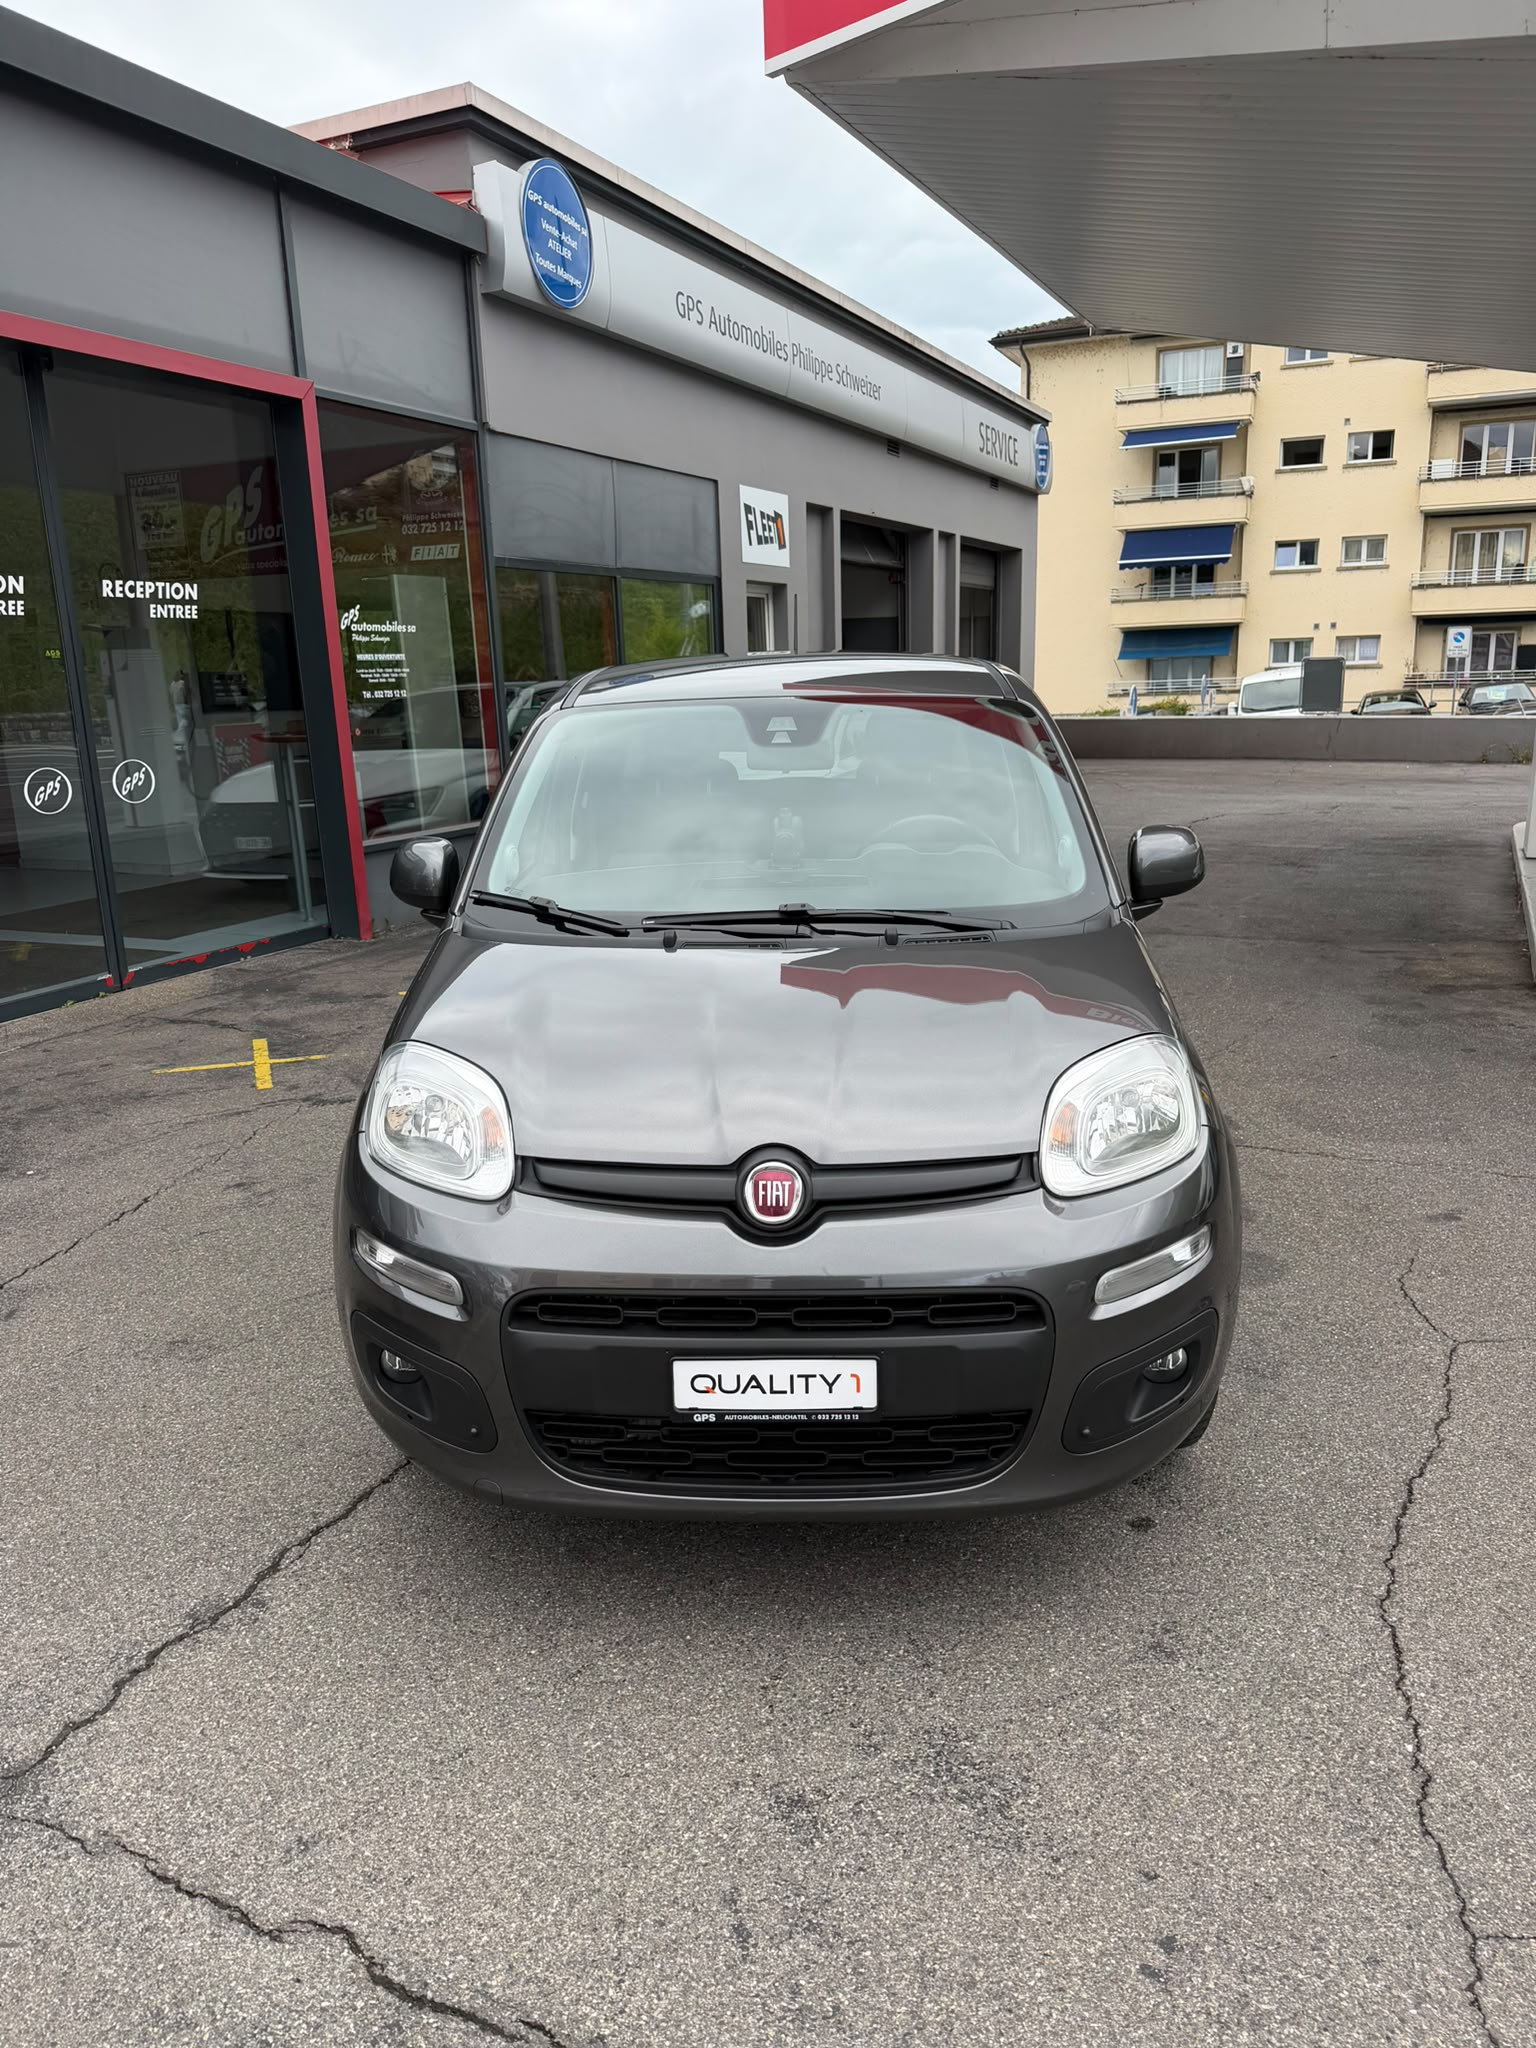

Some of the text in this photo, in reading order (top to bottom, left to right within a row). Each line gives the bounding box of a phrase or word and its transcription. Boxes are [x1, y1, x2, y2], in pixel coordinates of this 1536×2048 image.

[527, 190, 543, 206] GPS
[543, 201, 581, 231] automobiles
[541, 218, 578, 250] Vente-Achat
[547, 238, 572, 261] ATELIER
[535, 252, 582, 289] Toutes Marques
[675, 291, 882, 401] GPS Automobiles Philippe Schweizer
[979, 421, 1018, 466] SERVICE
[200, 466, 264, 563] GPS
[402, 514, 429, 522] Philippe
[402, 520, 465, 535] 032 725 12 12
[413, 545, 458, 560] FIAT
[102, 579, 198, 600] RECEPTION
[150, 604, 198, 619] ENTREE
[340, 604, 360, 630] GPS
[351, 621, 417, 633] automobiles sa
[35, 775, 62, 807] GPS
[122, 767, 146, 796] GPS
[758, 1180, 792, 1207] FIAT
[690, 1373, 861, 1395] QUALITY 1
[693, 1413, 716, 1422] GPS
